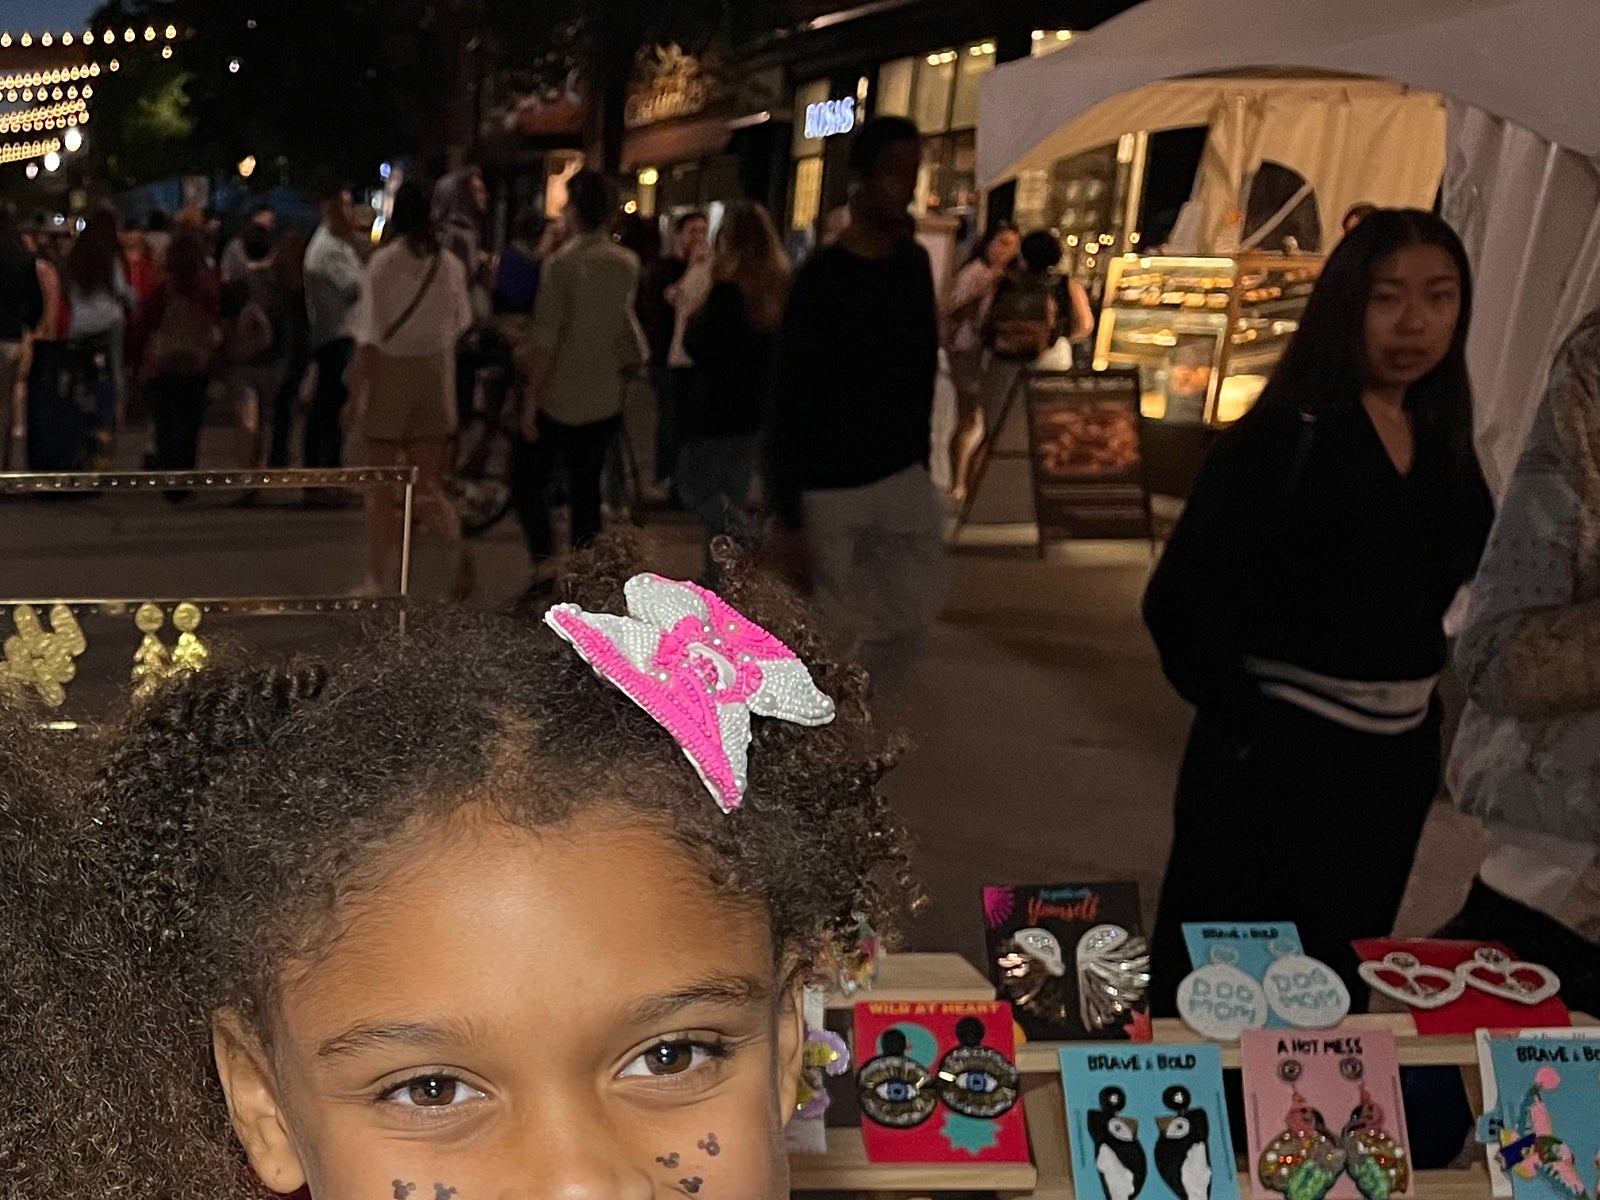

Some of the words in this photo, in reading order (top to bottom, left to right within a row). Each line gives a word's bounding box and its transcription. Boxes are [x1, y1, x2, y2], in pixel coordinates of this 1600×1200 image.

[869, 1003, 909, 1015] WILD
[915, 1003, 935, 1015] AT
[941, 1002, 999, 1015] HEART
[1277, 1038, 1288, 1055] A
[1291, 1038, 1319, 1055] HOT
[1324, 1036, 1363, 1055] MESS
[1516, 1045, 1569, 1062] BRAVE
[1087, 1053, 1142, 1071] BRAVE
[1157, 1053, 1197, 1070] BOLD
